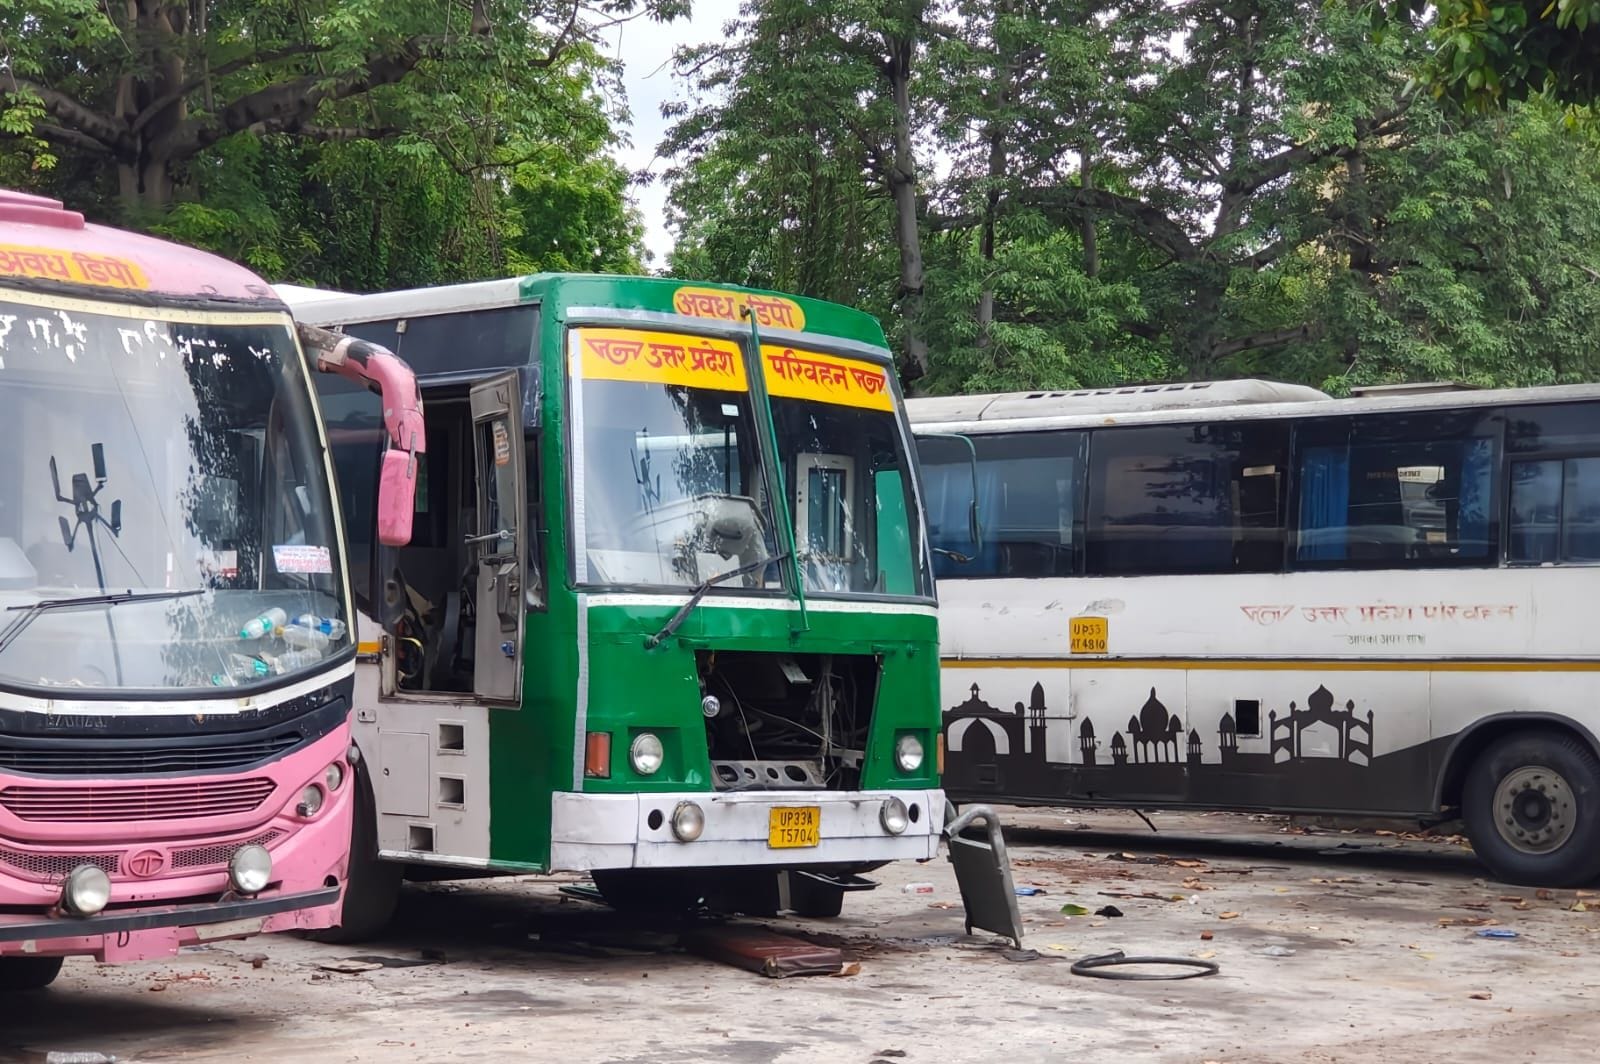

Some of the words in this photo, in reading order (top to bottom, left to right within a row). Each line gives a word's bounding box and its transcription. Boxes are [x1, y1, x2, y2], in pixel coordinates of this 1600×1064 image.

[0, 250, 71, 278] अवध
[72, 252, 138, 287] डिपो
[676, 293, 735, 320] अवध
[644, 343, 688, 371] उत्तर
[688, 340, 736, 377] प्रदेश
[767, 349, 849, 393] परिवहन
[1300, 606, 1350, 624] उत्तर
[1073, 623, 1102, 636] UP33
[780, 811, 813, 827] UP33A
[780, 828, 813, 843] T5704
